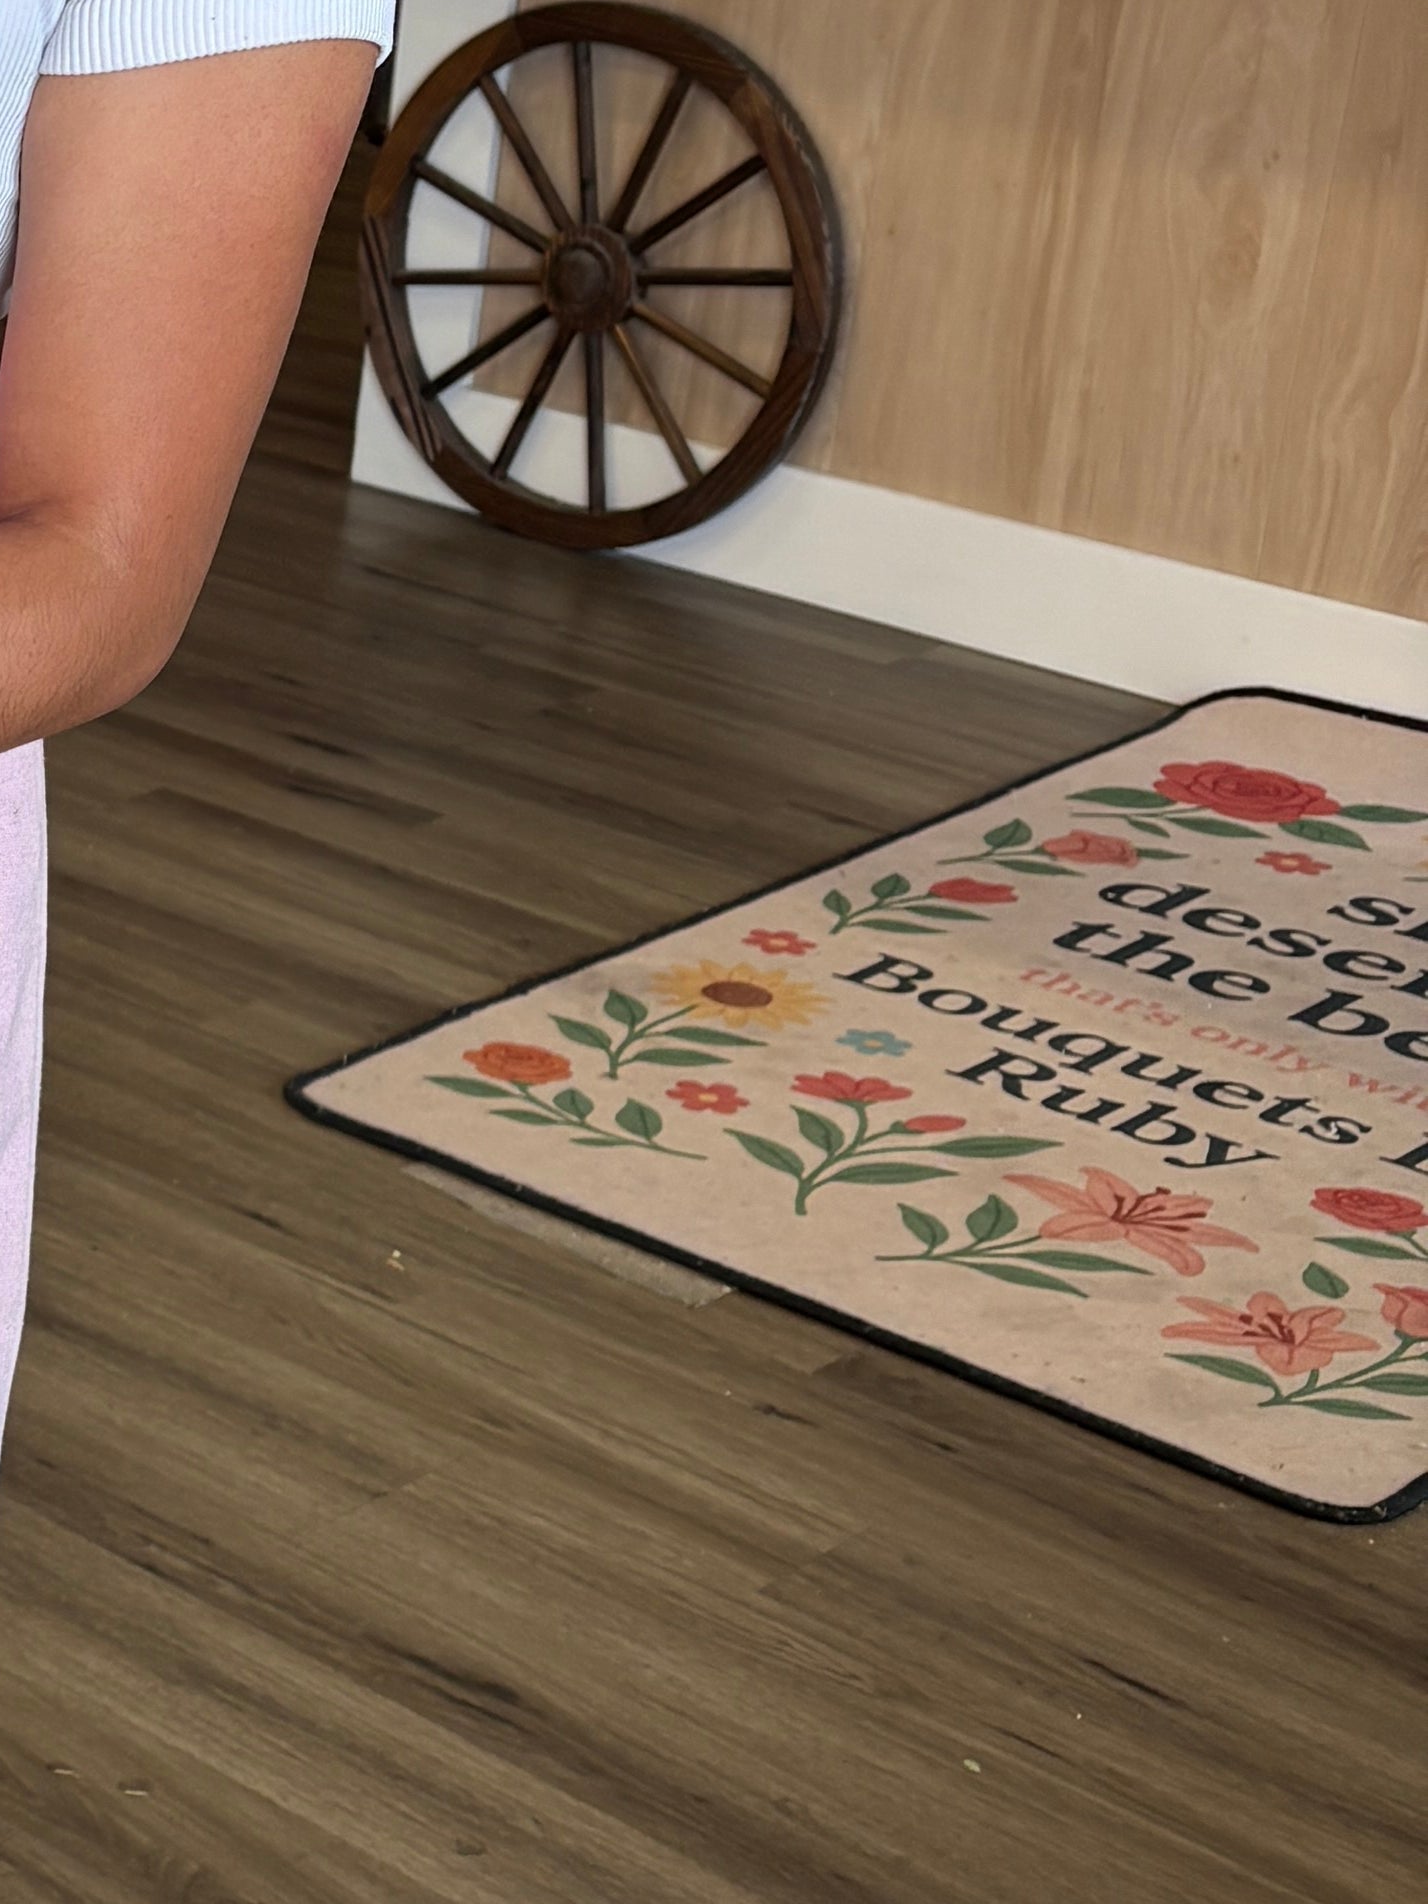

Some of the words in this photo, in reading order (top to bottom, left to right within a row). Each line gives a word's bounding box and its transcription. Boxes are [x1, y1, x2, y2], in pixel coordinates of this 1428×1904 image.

[1053, 921, 1271, 1001] the
[832, 952, 1373, 1146] Bouquets
[1019, 968, 1179, 1027] that's
[1190, 1025, 1330, 1073] only
[946, 1047, 1280, 1169] Ruby
